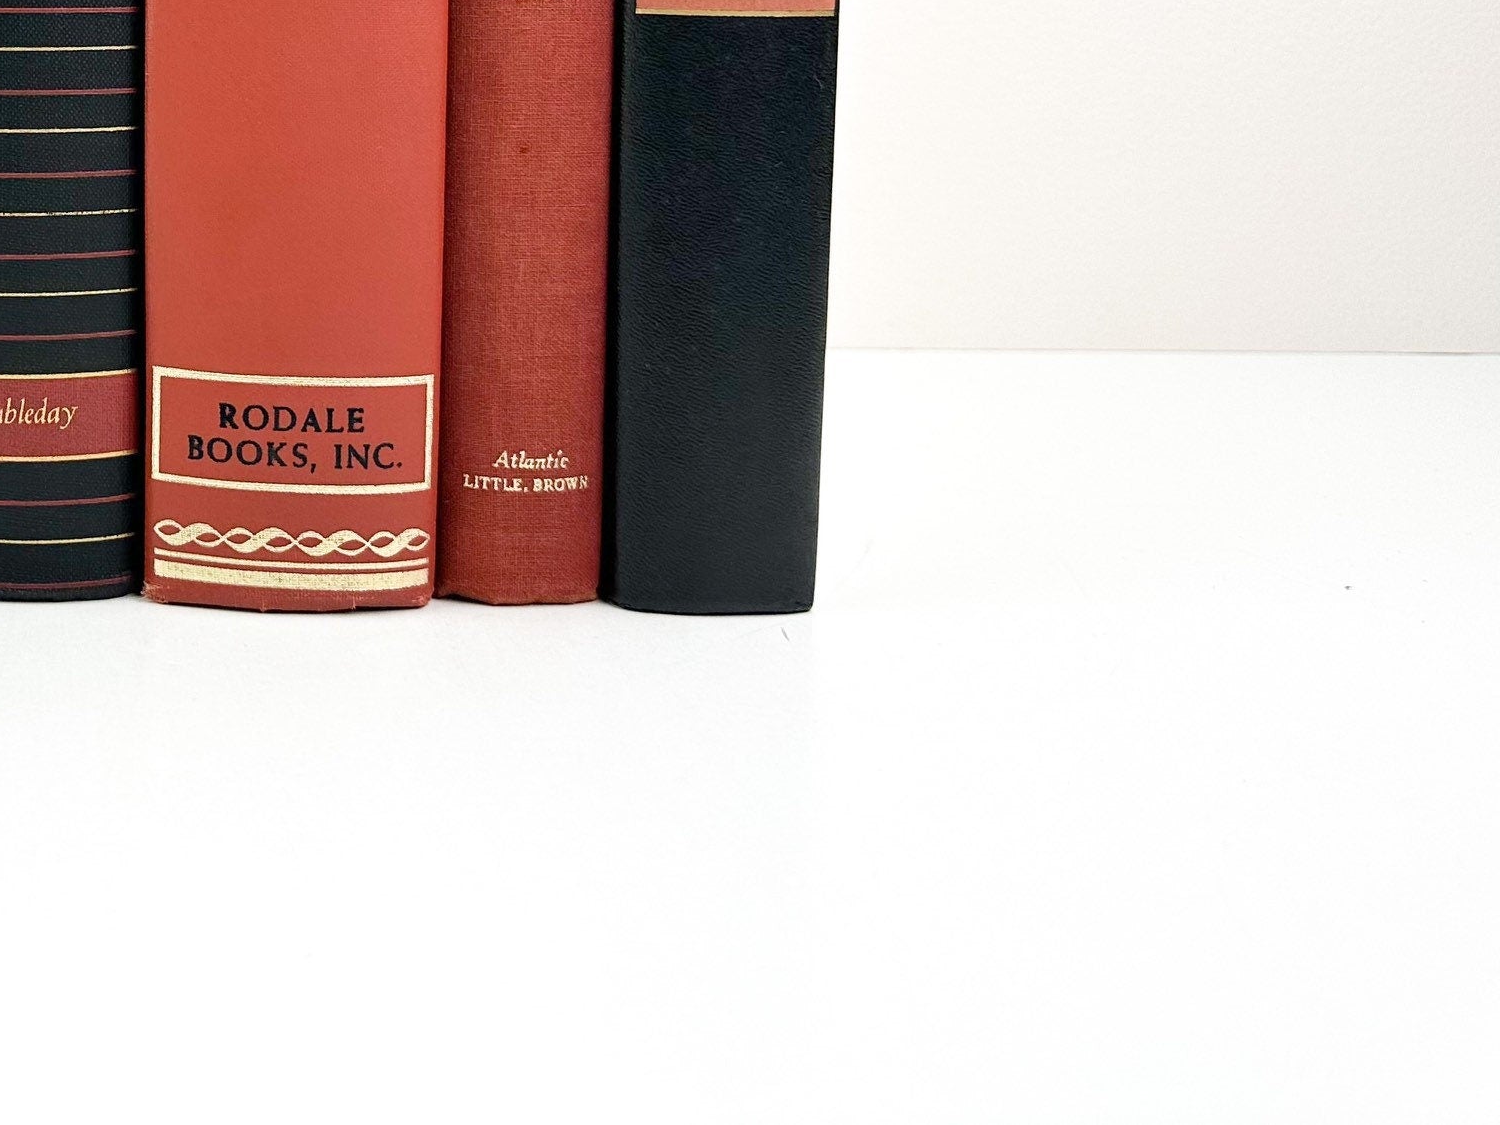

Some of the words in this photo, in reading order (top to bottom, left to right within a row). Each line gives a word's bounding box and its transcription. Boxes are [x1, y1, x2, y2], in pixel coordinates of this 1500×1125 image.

[218, 402, 365, 435] RODALE
[187, 434, 317, 474] BOOKS,
[334, 443, 402, 471] INC.
[492, 449, 570, 469] Atlantic
[463, 473, 528, 493] LITTLE,
[532, 475, 589, 493] BROWN
